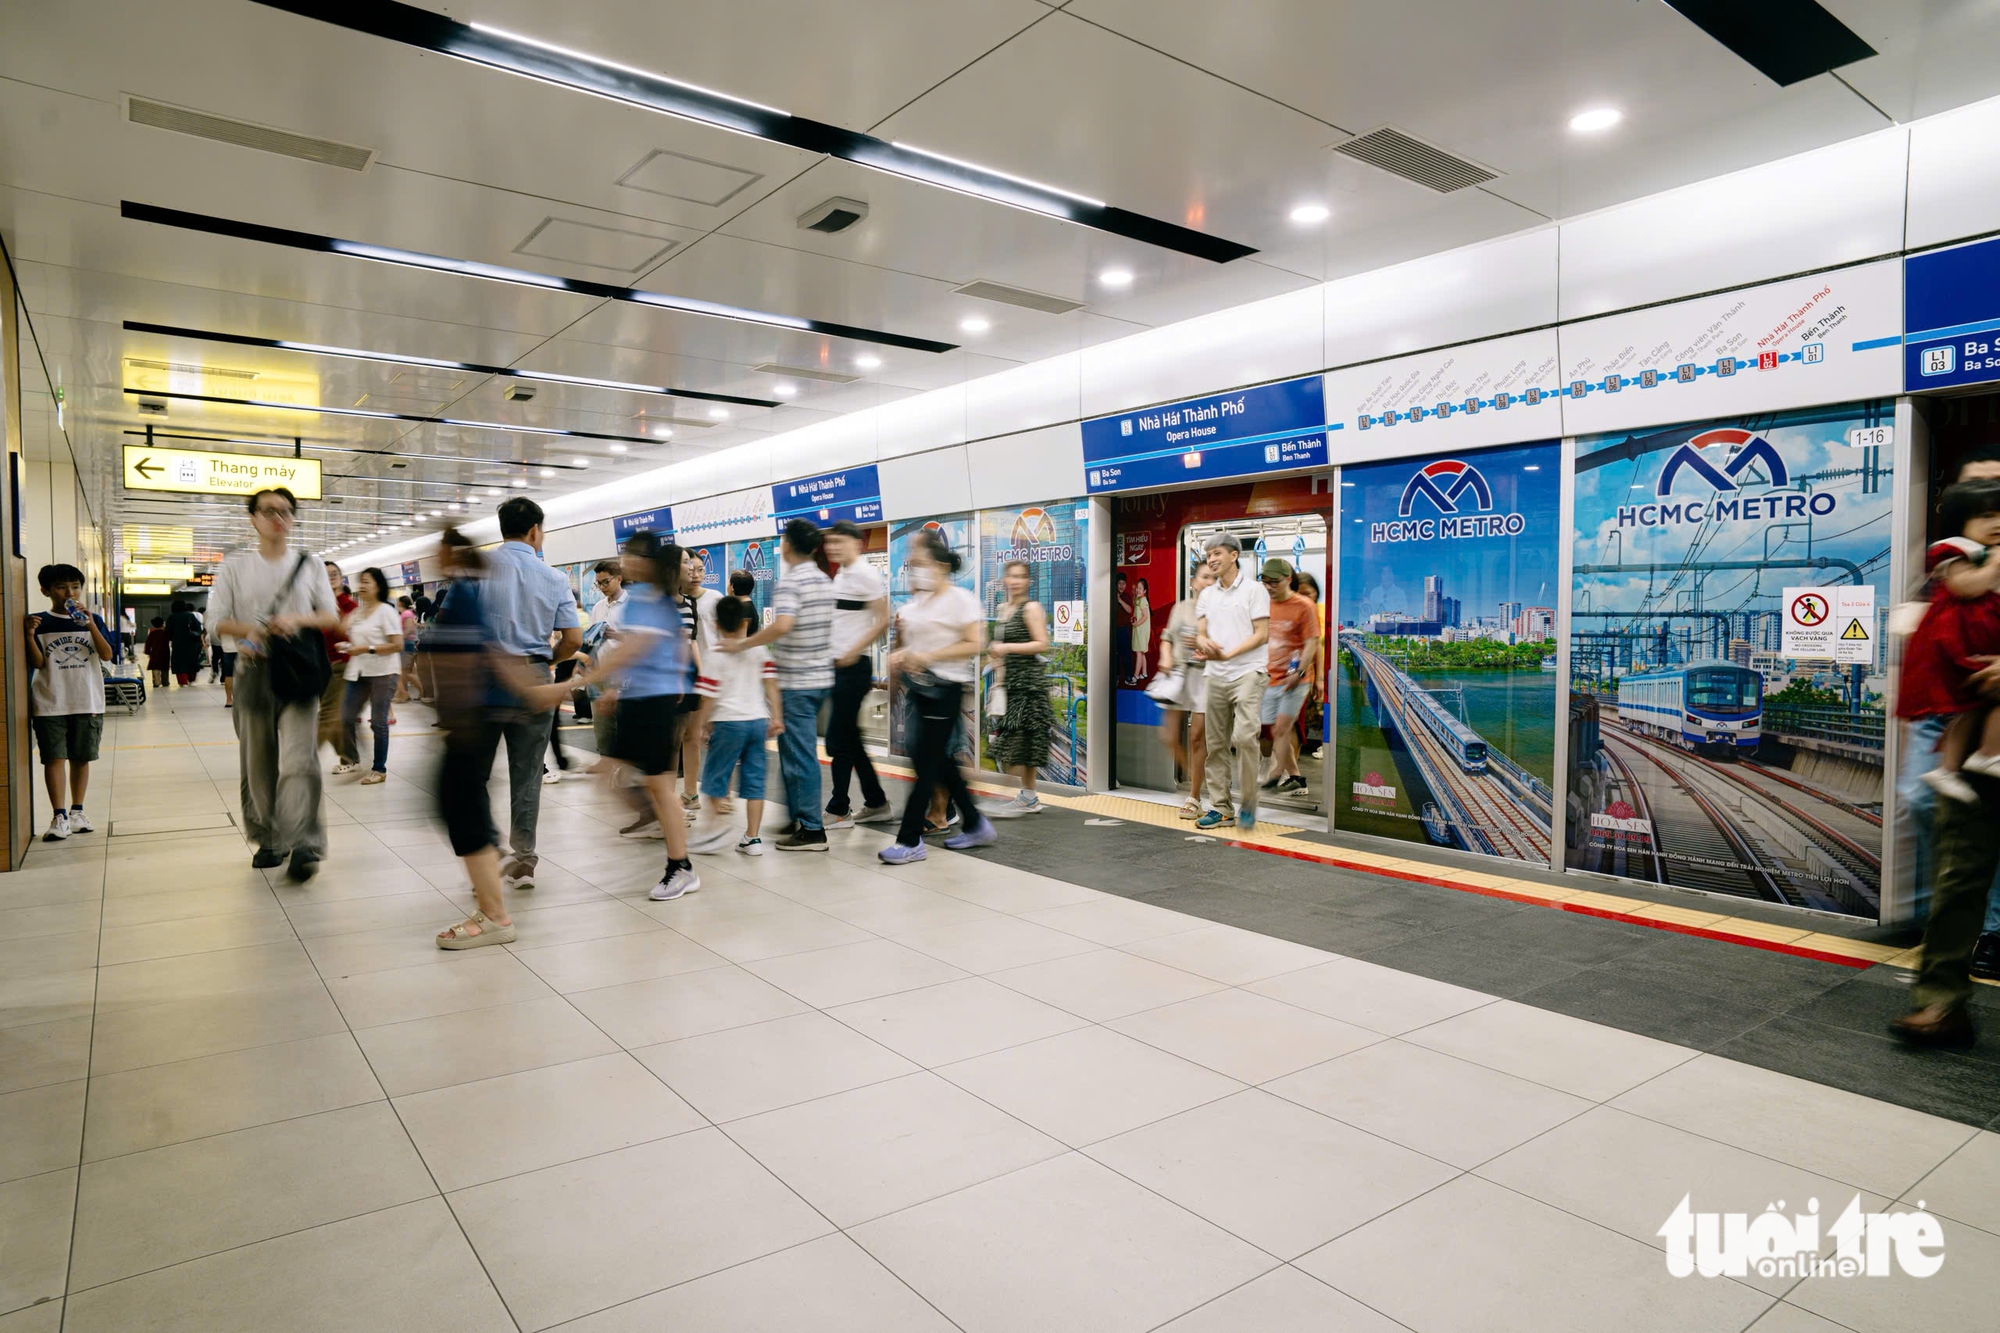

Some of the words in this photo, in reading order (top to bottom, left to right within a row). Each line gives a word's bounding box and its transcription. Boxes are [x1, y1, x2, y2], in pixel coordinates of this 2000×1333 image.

[1787, 301, 1814, 323] Thành
[1813, 285, 1831, 302] Phố
[1801, 328, 1819, 341] Bến
[1817, 304, 1846, 327] Thành
[1817, 329, 1830, 339] Ben
[1829, 314, 1847, 331] Thanh
[1772, 334, 1788, 347] Opera
[1788, 319, 1805, 334] House
[1716, 346, 1727, 355] Ba
[1727, 332, 1743, 347] Son
[1808, 346, 1817, 354] L1
[1964, 341, 1988, 357] Ba
[1808, 354, 1817, 362] 01
[1932, 351, 1945, 361] L1
[1510, 360, 1526, 375] Long
[1931, 361, 1945, 371] 03
[1964, 360, 1981, 371] Ba
[1985, 357, 2000, 368] So
[1568, 369, 1578, 380] An
[1138, 415, 1161, 432] Nhà
[1163, 411, 1180, 428] Hát
[1183, 403, 1219, 423] Thành
[1221, 396, 1246, 417] Phố
[1166, 429, 1190, 444] Opera
[1191, 425, 1217, 439] House
[1856, 429, 1884, 444] 1-16
[1281, 441, 1296, 453] Bến
[1296, 438, 1321, 451] Thành
[1282, 454, 1293, 462] Ben
[1293, 451, 1310, 460] Thanh
[210, 459, 258, 478] Thang
[264, 465, 296, 480] máy
[1102, 469, 1110, 478] Ba
[1110, 467, 1121, 476] Son
[209, 477, 255, 488] Elevator
[798, 485, 809, 494] Nhà
[835, 475, 846, 487] Phố
[811, 494, 822, 503] Opera
[822, 492, 834, 500] House
[1121, 493, 1169, 518] iority
[1618, 502, 1704, 528] HCMC
[1715, 493, 1836, 522] METRO
[1371, 519, 1435, 543] HCMC
[1440, 513, 1524, 539] METRO
[1126, 535, 1135, 543] TÌM
[1136, 534, 1148, 543] HIỂU
[996, 548, 1028, 563] HCMC
[1030, 545, 1072, 561] METRO
[1354, 784, 1374, 794] HOA
[1592, 817, 1620, 828] HOA
[1627, 821, 1649, 832] SEN
[1706, 859, 1725, 867] MANG
[1782, 870, 1804, 879] METRO
[1833, 877, 1850, 885] HƠN
